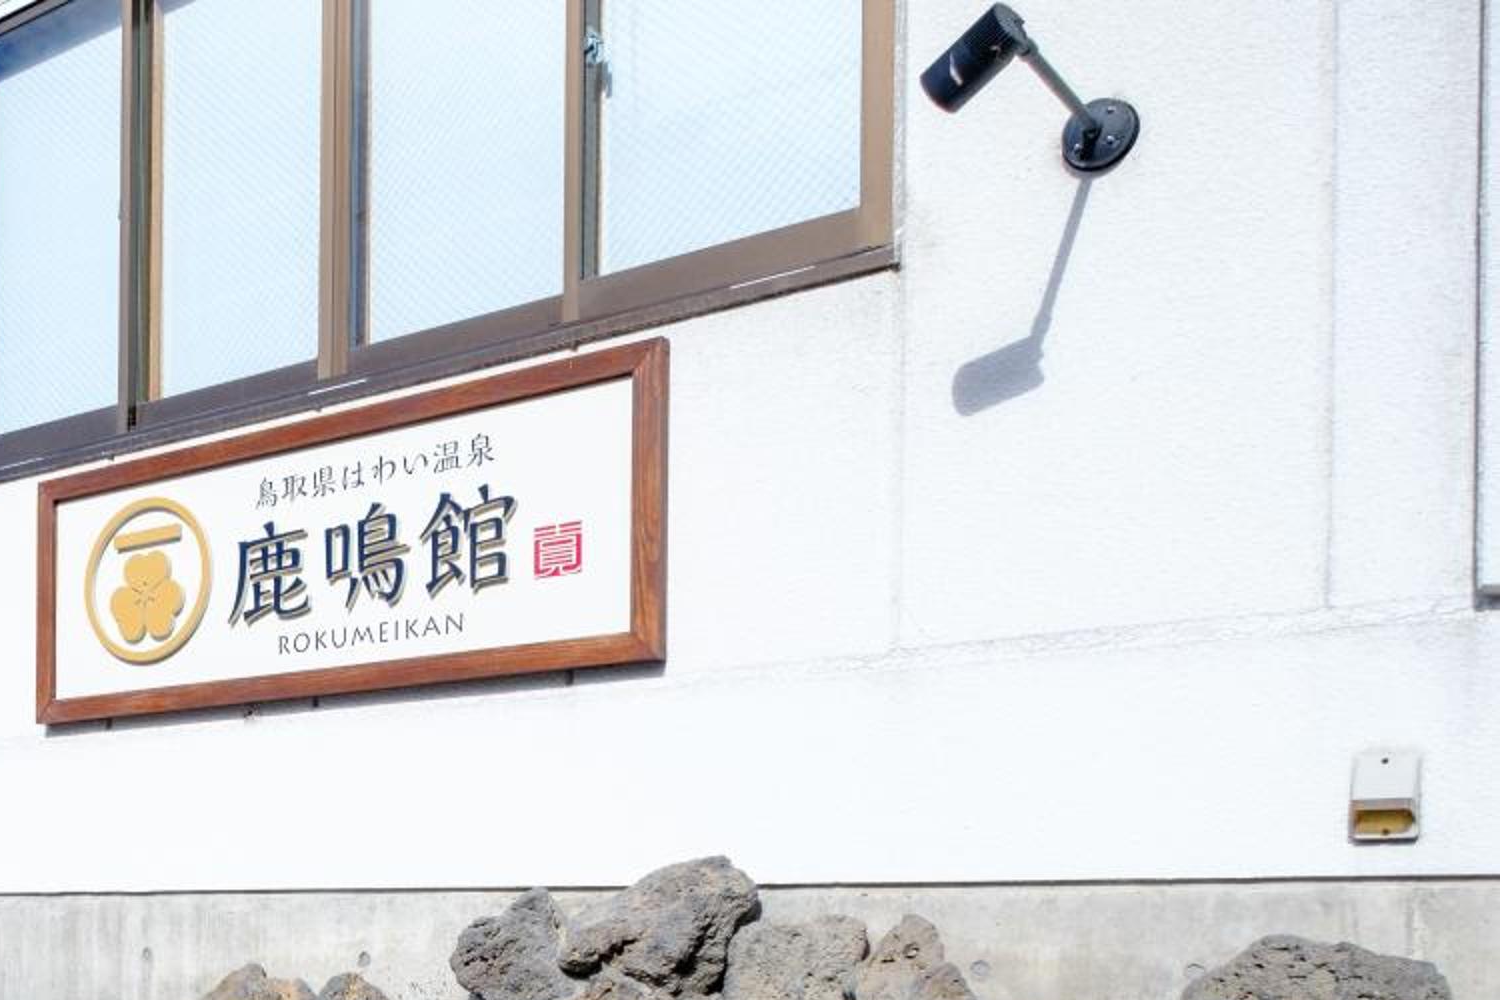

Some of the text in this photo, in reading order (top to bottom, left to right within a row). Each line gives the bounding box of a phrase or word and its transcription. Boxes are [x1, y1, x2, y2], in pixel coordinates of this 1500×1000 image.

[256, 433, 495, 509] 鳥取県はわい温泉
[228, 484, 517, 626] 鹿鳴館
[278, 613, 464, 654] ROKUMEIKAN
